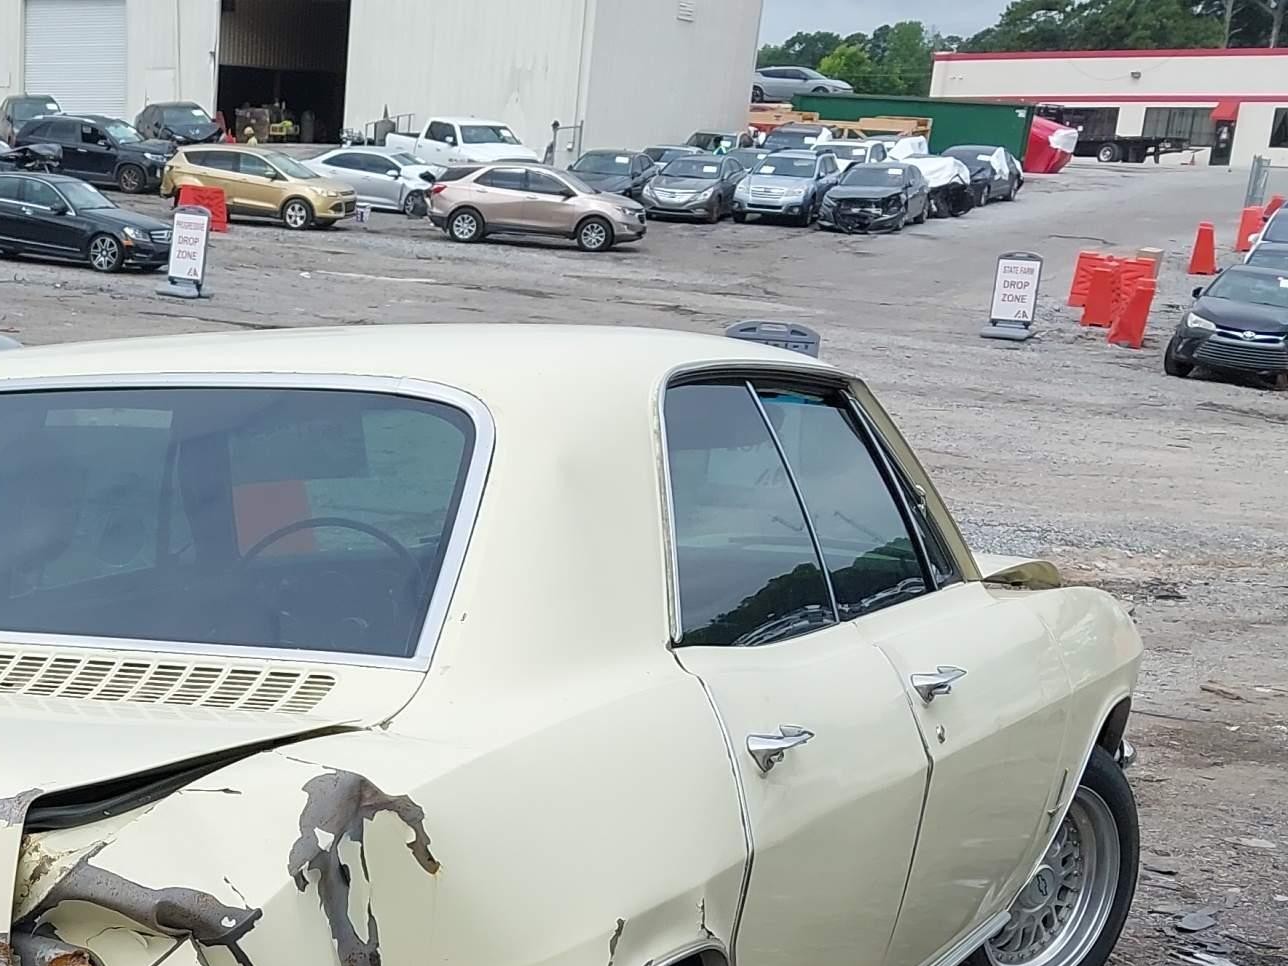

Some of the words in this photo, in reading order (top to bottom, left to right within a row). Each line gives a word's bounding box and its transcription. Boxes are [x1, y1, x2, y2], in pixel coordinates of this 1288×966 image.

[177, 235, 200, 246] DROP
[176, 249, 198, 261] ZONE
[1003, 280, 1030, 290] DROP
[1001, 293, 1028, 304] ZONE
